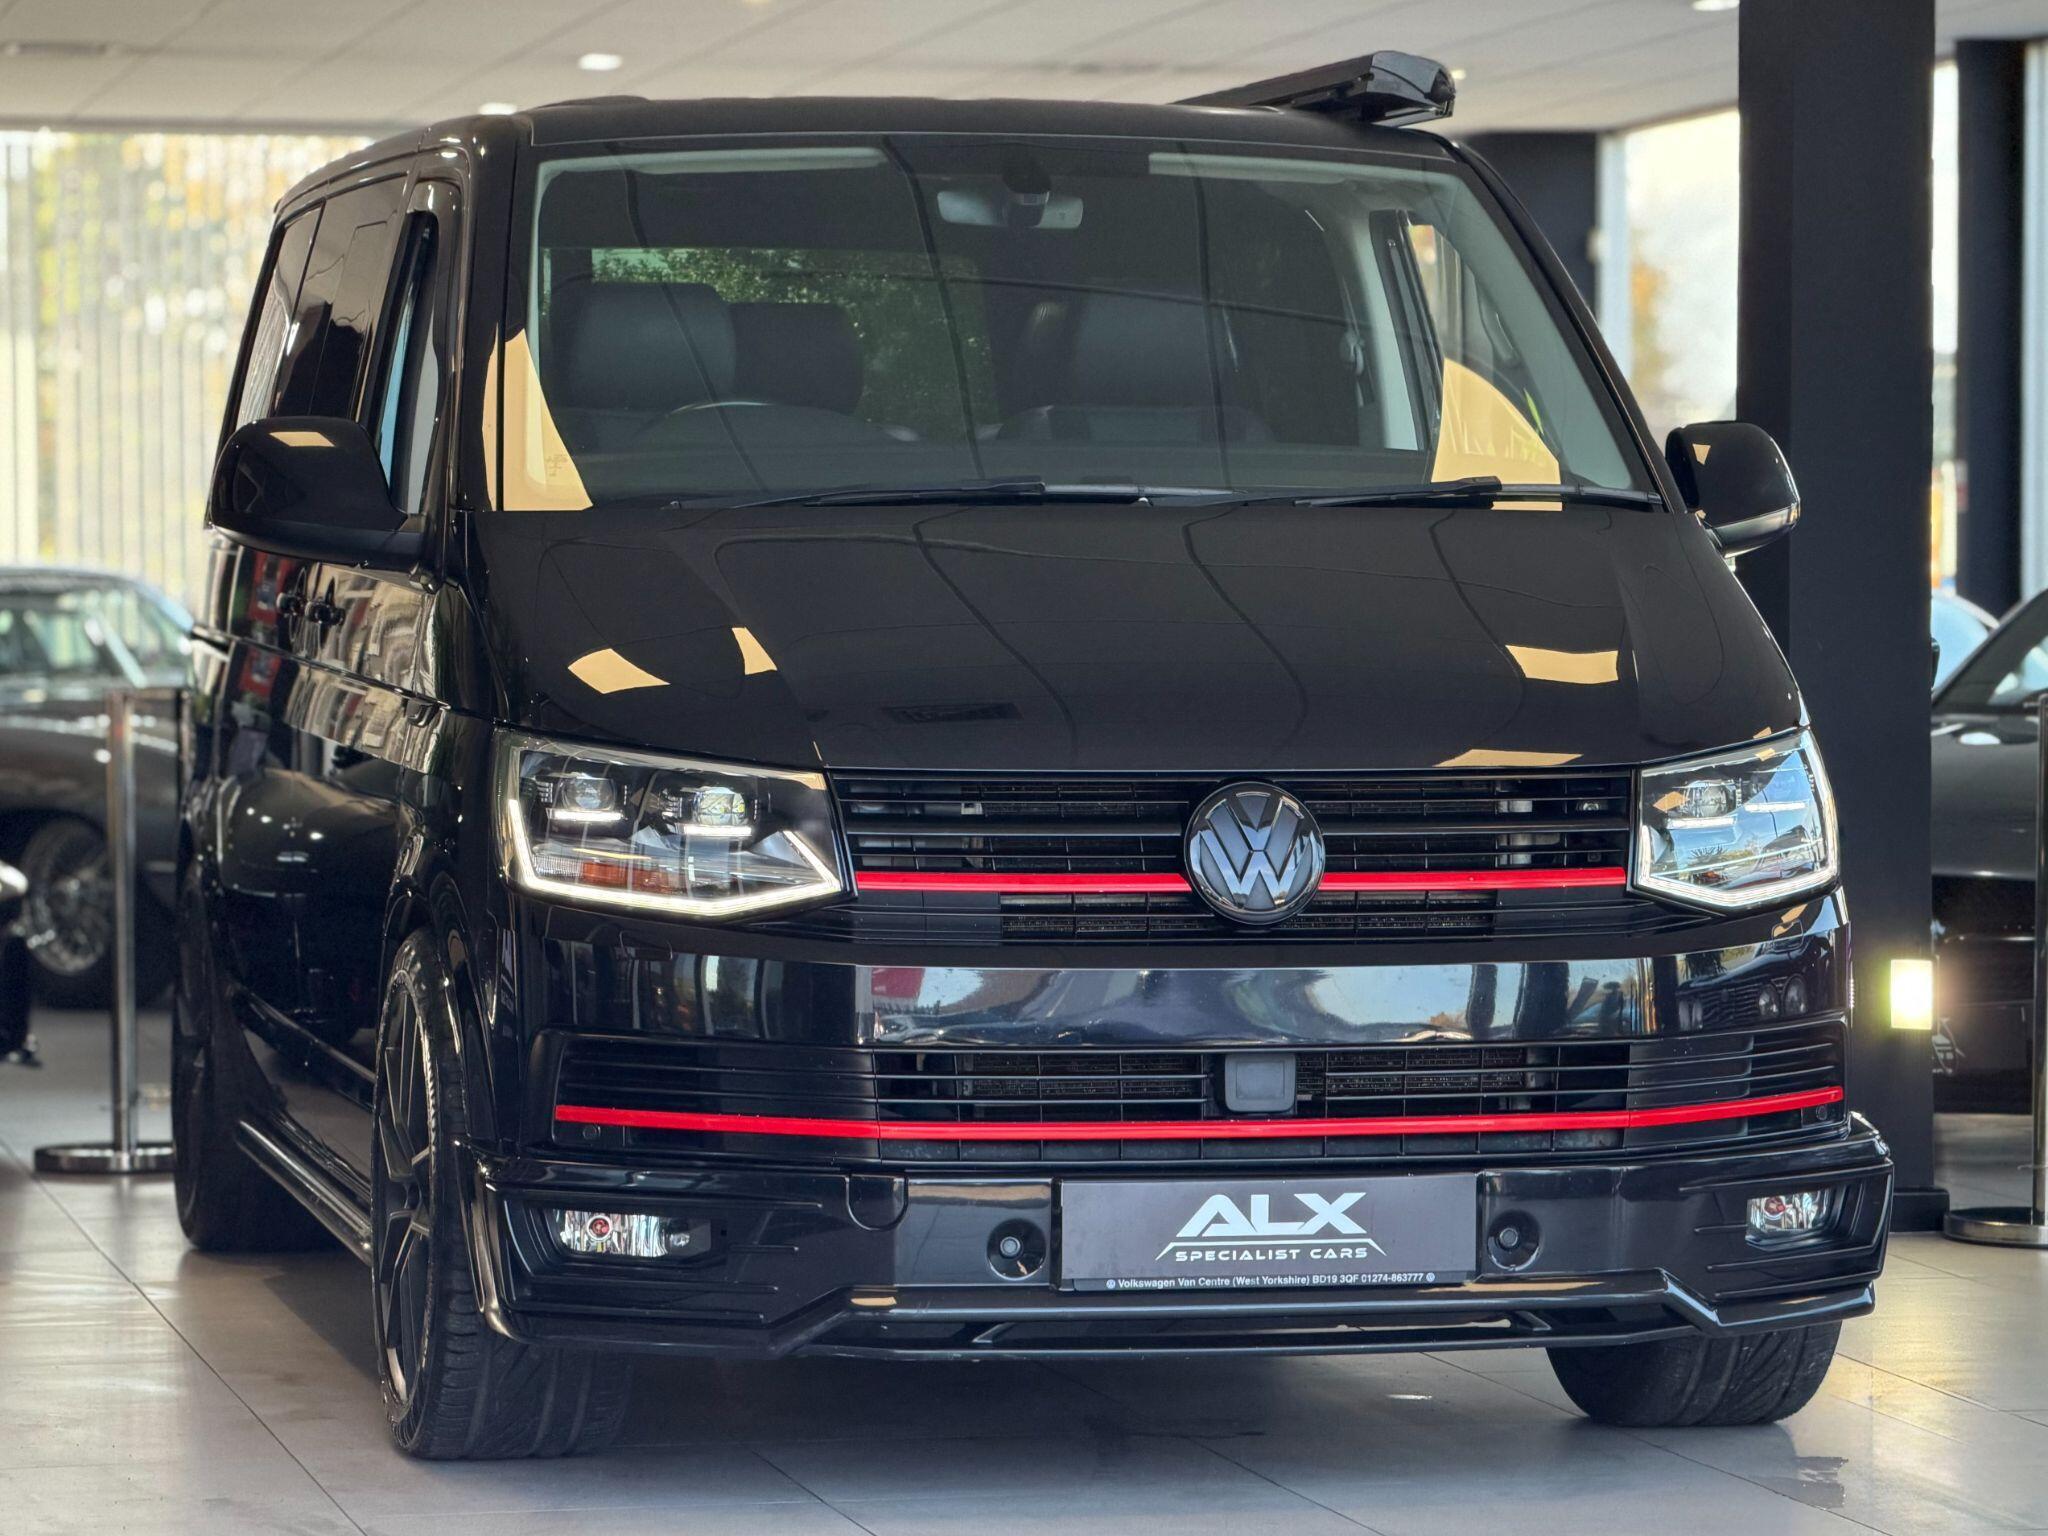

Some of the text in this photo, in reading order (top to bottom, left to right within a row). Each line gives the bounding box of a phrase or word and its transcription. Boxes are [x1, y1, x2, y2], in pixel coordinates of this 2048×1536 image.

[1190, 786, 1320, 914] VW
[1175, 1191, 1368, 1238] ALX
[1175, 1247, 1368, 1262] SPECIALIST CARS
[1118, 1278, 1175, 1290] Volkswagen
[1178, 1277, 1196, 1287] Van
[1199, 1277, 1230, 1287] Centre
[1232, 1276, 1260, 1287] (West
[1261, 1275, 1310, 1286] Yorkshire)
[1312, 1274, 1337, 1284] BD19
[1339, 1273, 1359, 1284] 3QF
[1361, 1272, 1424, 1283] 01274-863777
